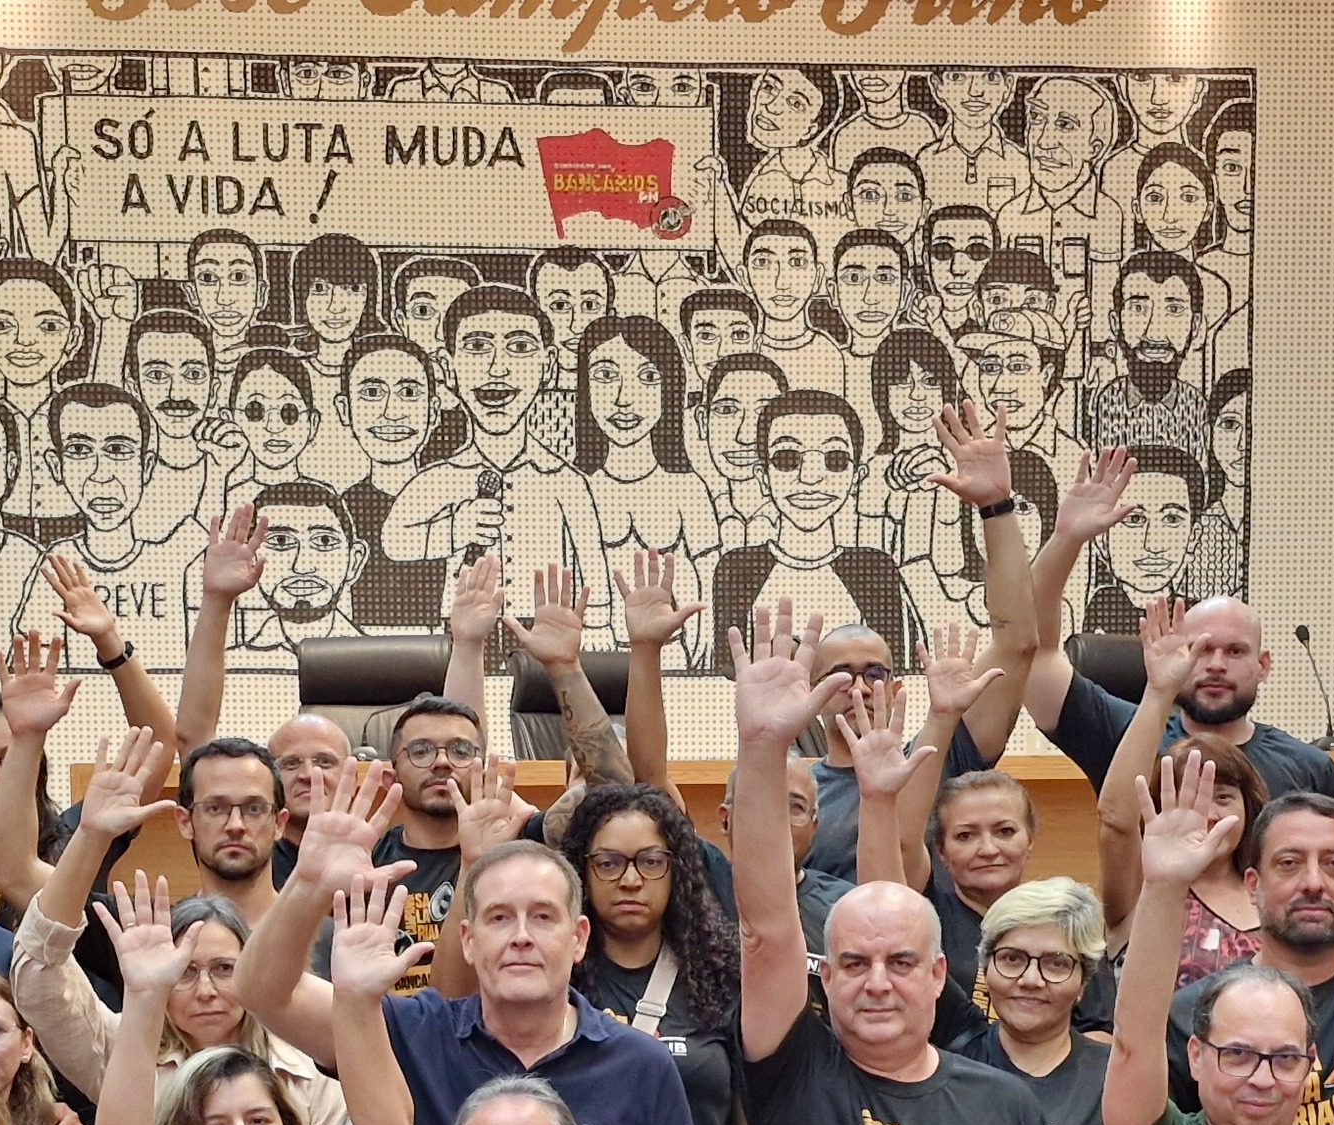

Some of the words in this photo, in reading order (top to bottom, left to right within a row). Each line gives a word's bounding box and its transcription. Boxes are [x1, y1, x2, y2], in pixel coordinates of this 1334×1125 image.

[92, 107, 155, 160] SÓ
[178, 120, 211, 162] A
[232, 121, 354, 165] LUTA
[384, 125, 526, 168] MUDA
[121, 173, 152, 215] A
[166, 174, 285, 216] VIDA
[746, 195, 848, 218] SOCIALISMO
[94, 582, 166, 618] REVE
